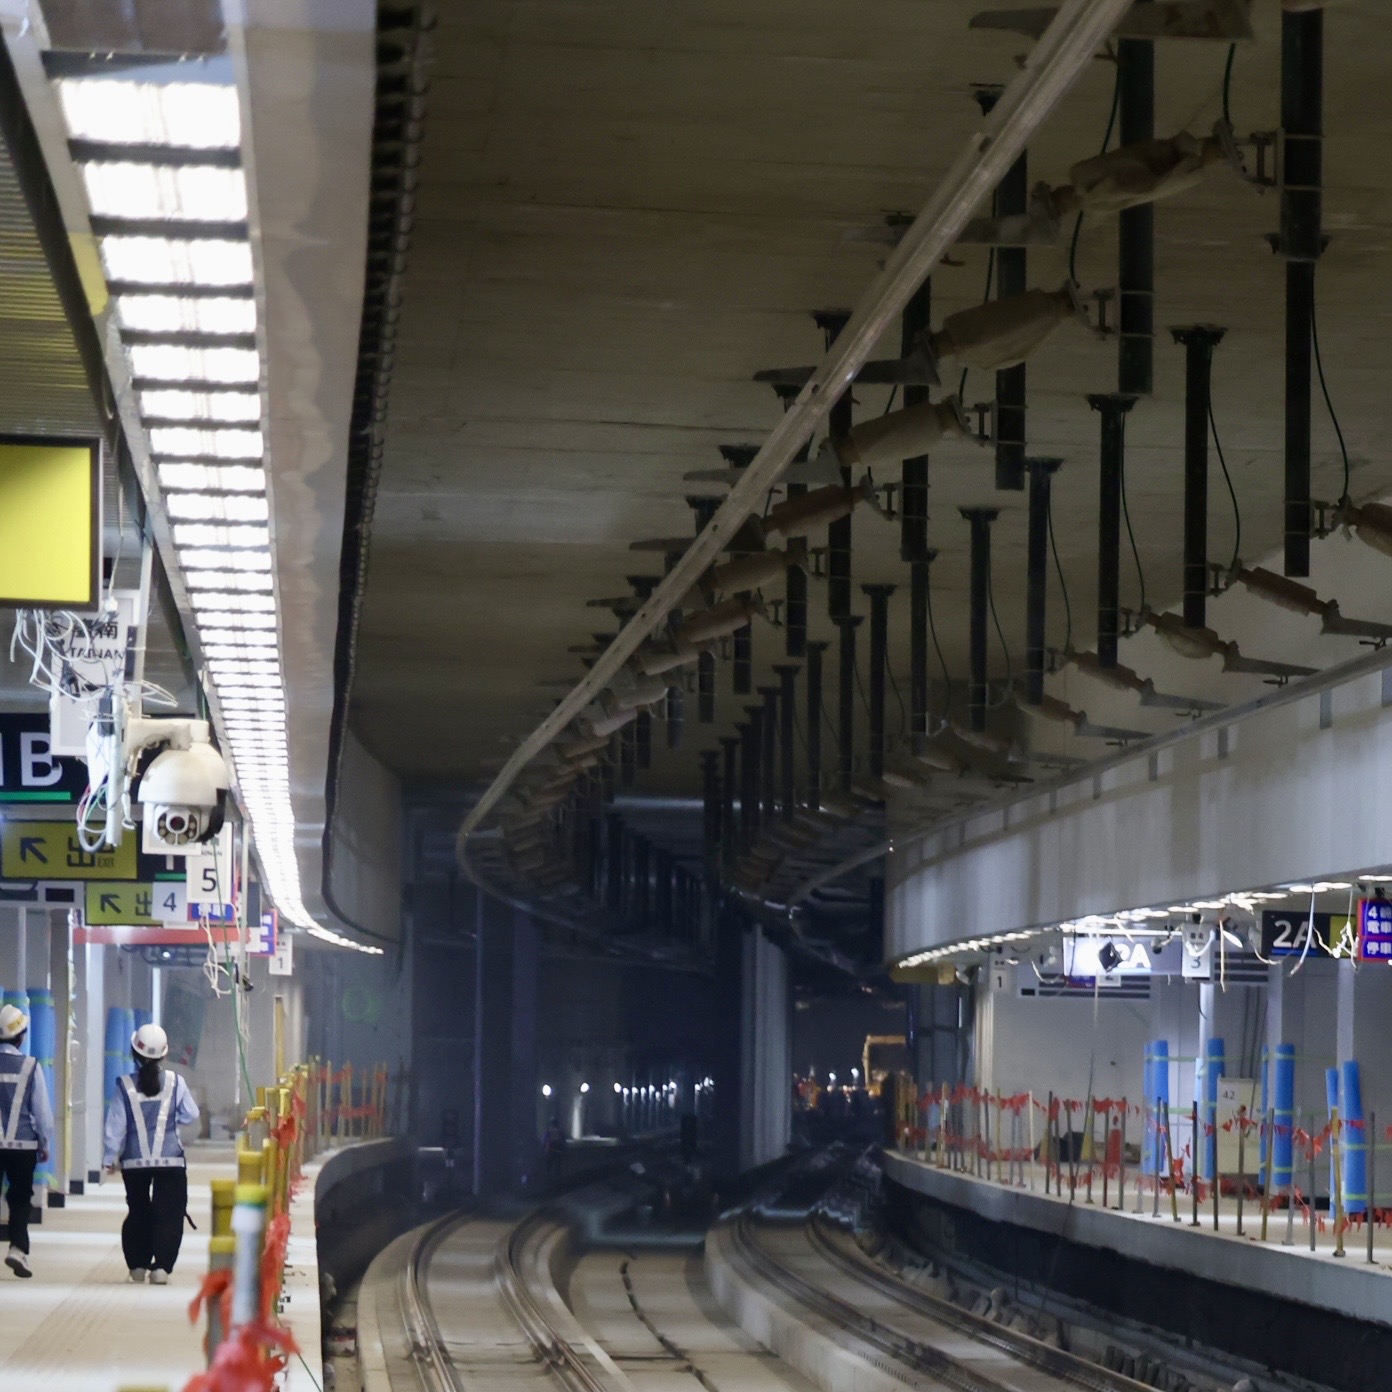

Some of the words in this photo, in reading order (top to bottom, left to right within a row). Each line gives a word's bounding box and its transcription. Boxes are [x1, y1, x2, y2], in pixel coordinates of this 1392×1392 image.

[0, 731, 63, 786] B
[202, 868, 217, 892] 5
[163, 892, 177, 912] 4
[1273, 920, 1318, 949] 2A
[1115, 943, 1152, 969] 2A
